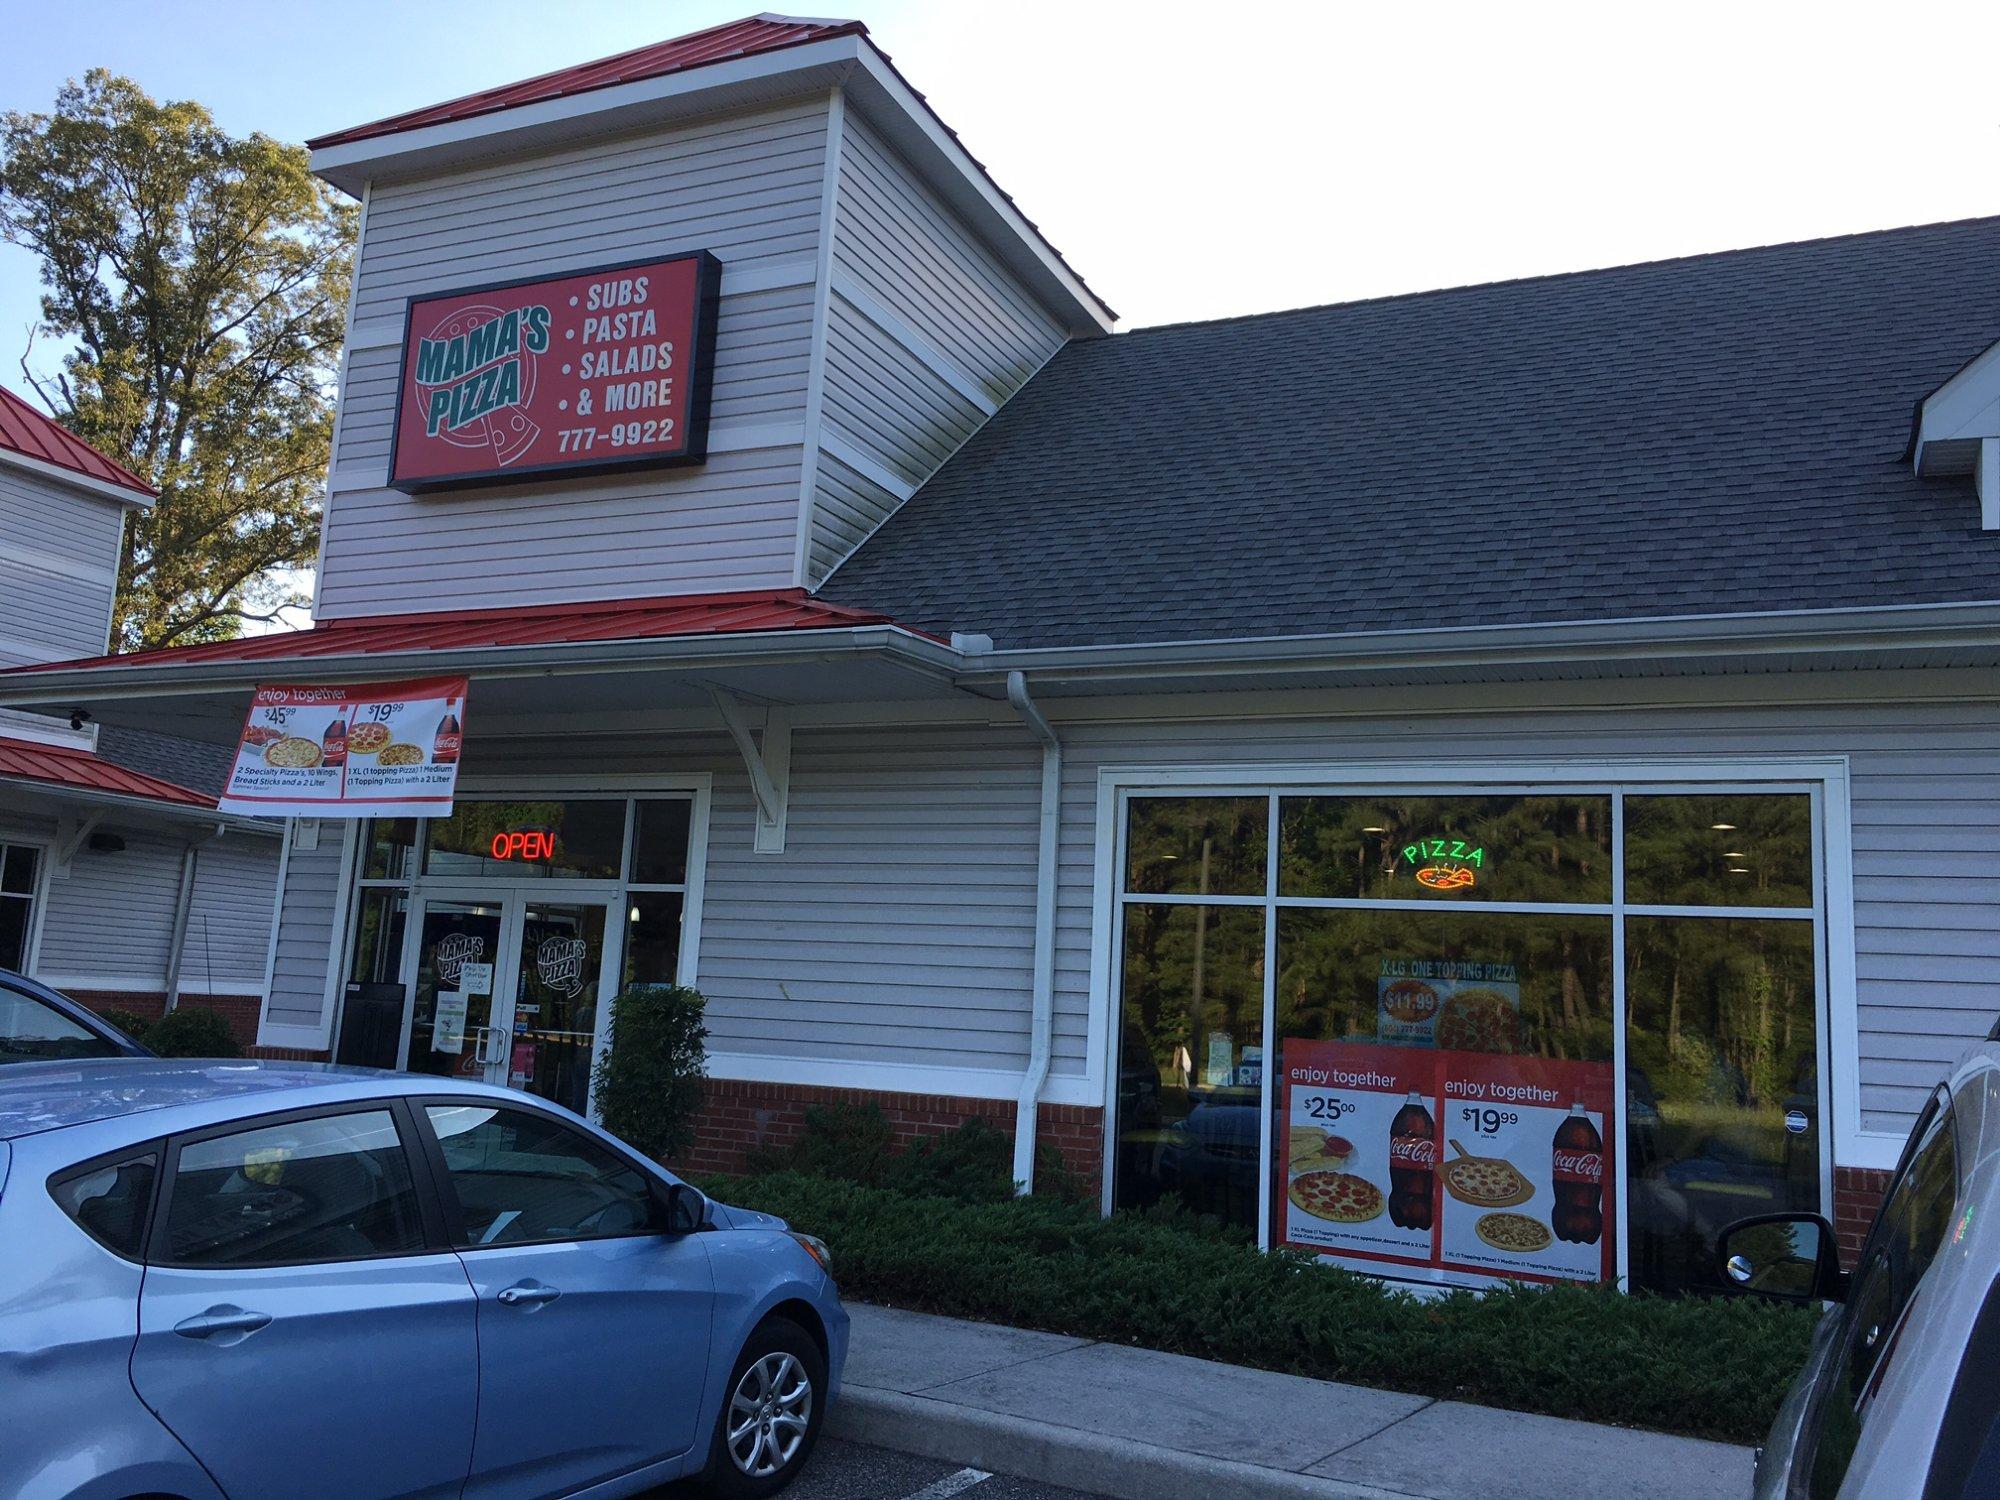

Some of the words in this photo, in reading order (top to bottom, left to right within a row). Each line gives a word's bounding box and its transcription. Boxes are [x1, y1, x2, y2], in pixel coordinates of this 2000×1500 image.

[587, 276, 648, 311] SUBS
[582, 309, 657, 344] PASTA
[415, 305, 552, 386] MAMA'S
[580, 342, 673, 379] SALADS
[426, 359, 520, 437] PIZZA
[576, 388, 593, 416] &
[605, 378, 673, 412] MORE
[558, 418, 674, 452] 777-9922
[258, 687, 290, 702] enjoy
[293, 687, 346, 702] together
[234, 776, 259, 785] Bread
[259, 777, 281, 786] Sticks
[244, 767, 278, 777] Specialty
[423, 764, 453, 773] Medium
[432, 775, 450, 783] Liter
[492, 832, 556, 859] OPEN
[1403, 840, 1483, 868] PIZZA
[437, 936, 484, 961] MAMA'S
[537, 939, 587, 965] MAMA'S
[541, 958, 576, 984] PIZZA
[1411, 961, 1434, 977] ONE
[1435, 962, 1482, 979] TOPPING
[1484, 964, 1517, 980] PIZZA
[1291, 1066, 1329, 1084] enjoy
[1333, 1069, 1397, 1088] together
[1444, 1079, 1486, 1098] enjoy
[1490, 1082, 1559, 1102] together
